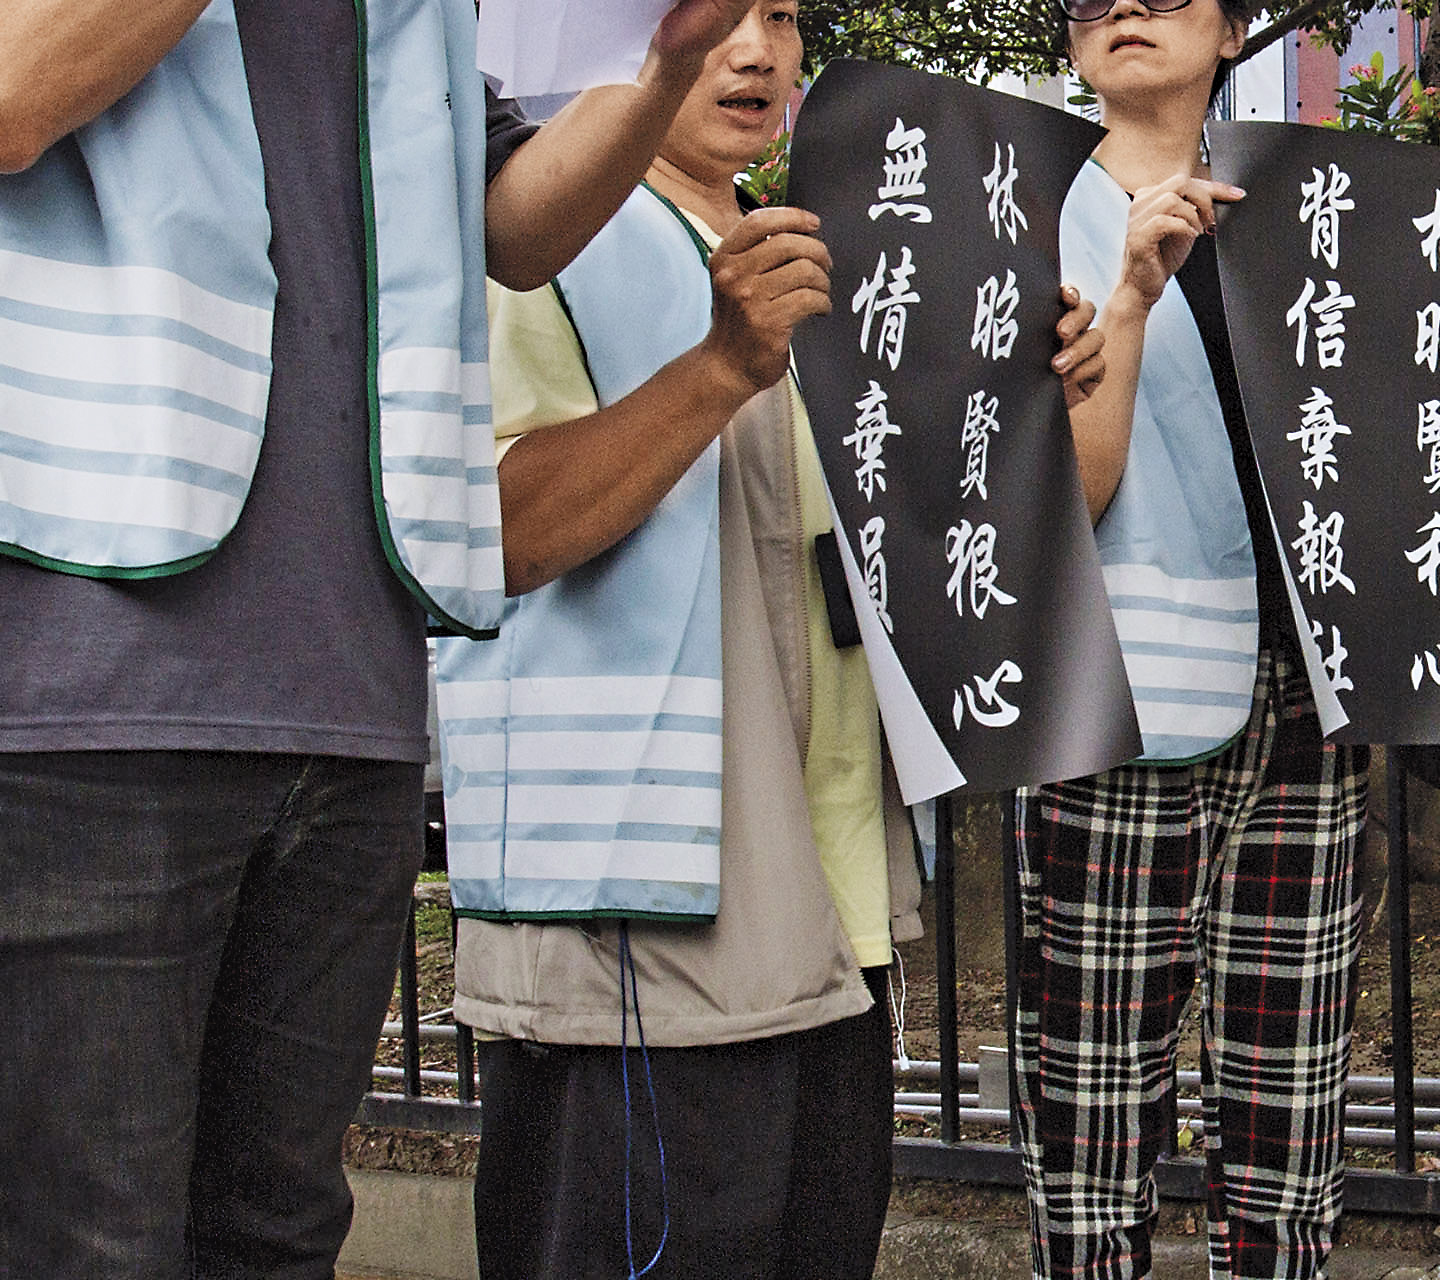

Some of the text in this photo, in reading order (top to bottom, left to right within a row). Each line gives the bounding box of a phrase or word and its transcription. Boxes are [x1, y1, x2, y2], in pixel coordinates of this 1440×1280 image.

[946, 142, 1030, 732] 林昭賢狠心
